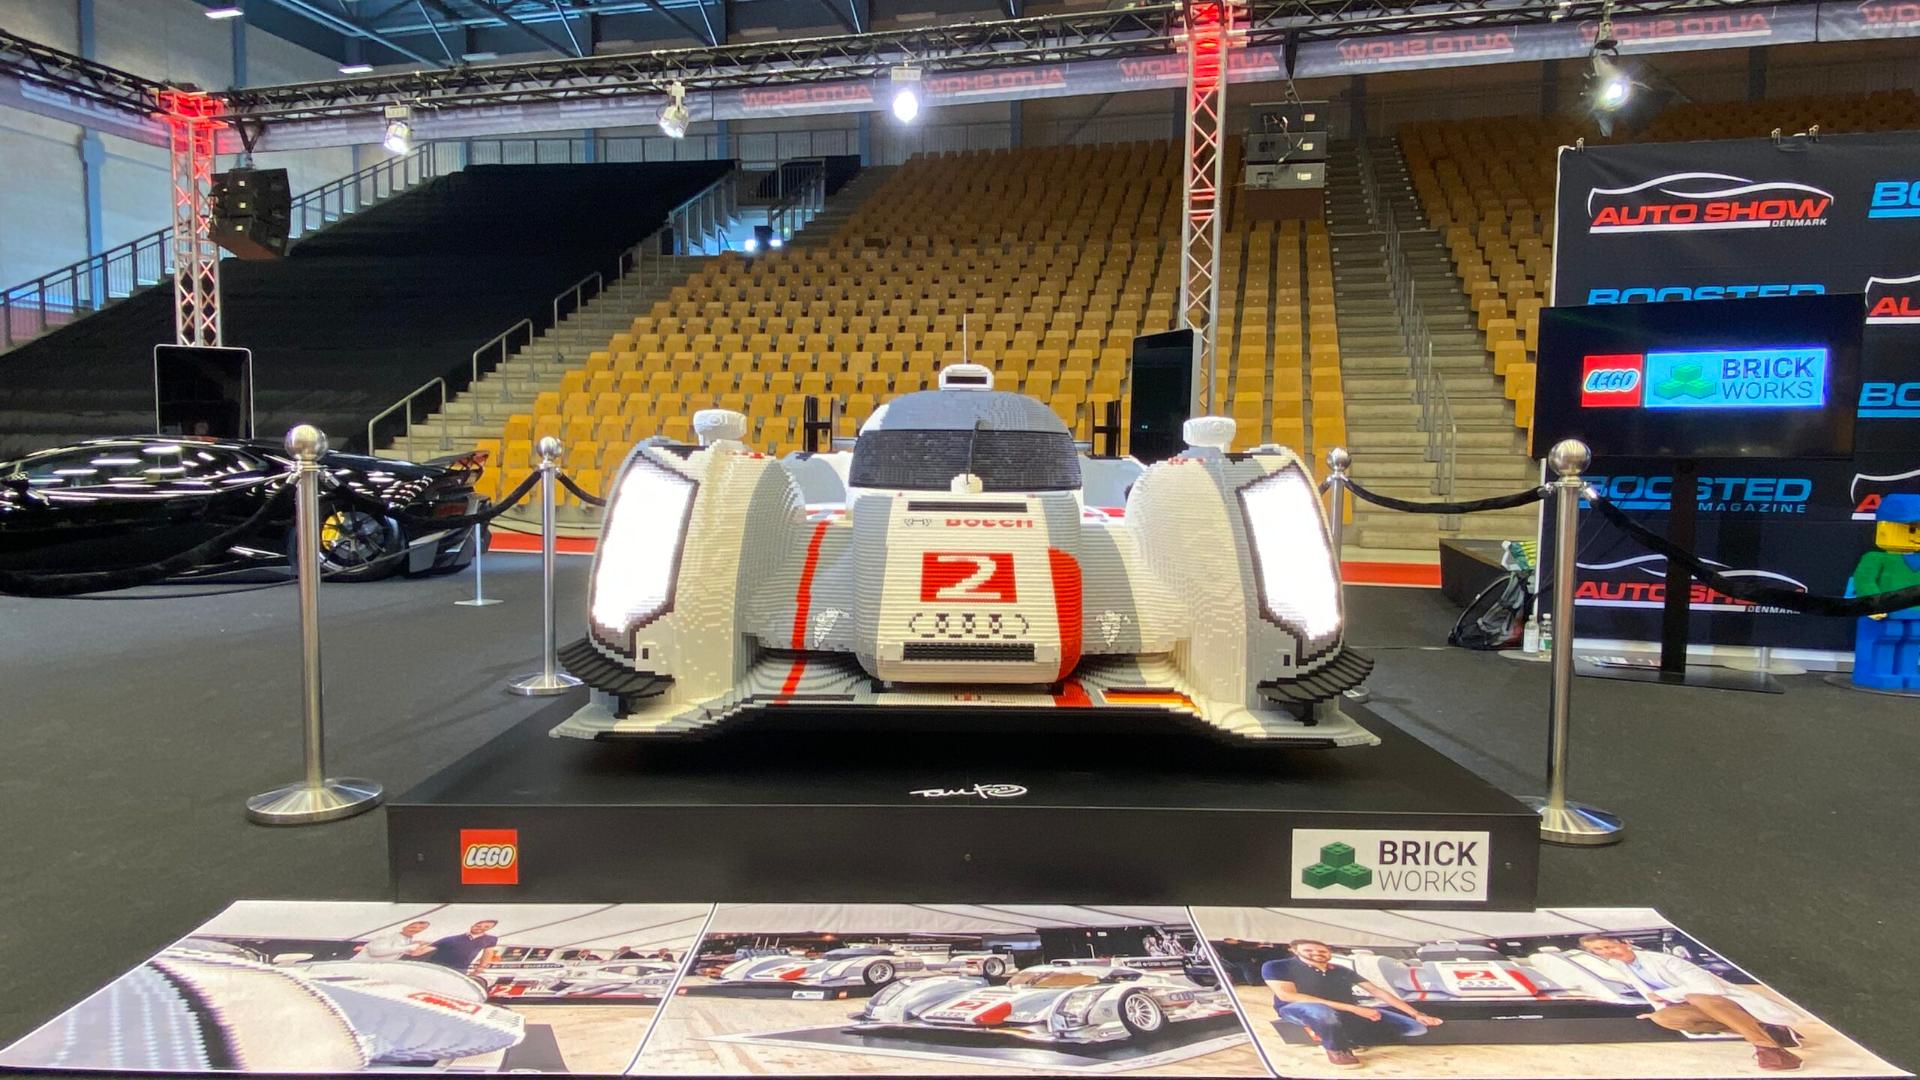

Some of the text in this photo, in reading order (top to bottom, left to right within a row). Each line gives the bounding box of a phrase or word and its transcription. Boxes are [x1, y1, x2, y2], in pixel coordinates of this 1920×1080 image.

[1592, 198, 1830, 226] AUTO SHOW
[1771, 218, 1828, 228] DENMARK
[1721, 356, 1816, 380] BRICK
[1585, 369, 1641, 392] LEGO
[1721, 380, 1814, 401] WORKS
[1697, 502, 1808, 514] MAGAZINE
[936, 554, 1001, 600] 2
[464, 844, 516, 868] LEGO
[1378, 839, 1479, 867] BRICK
[1377, 869, 1477, 893] WORKS
